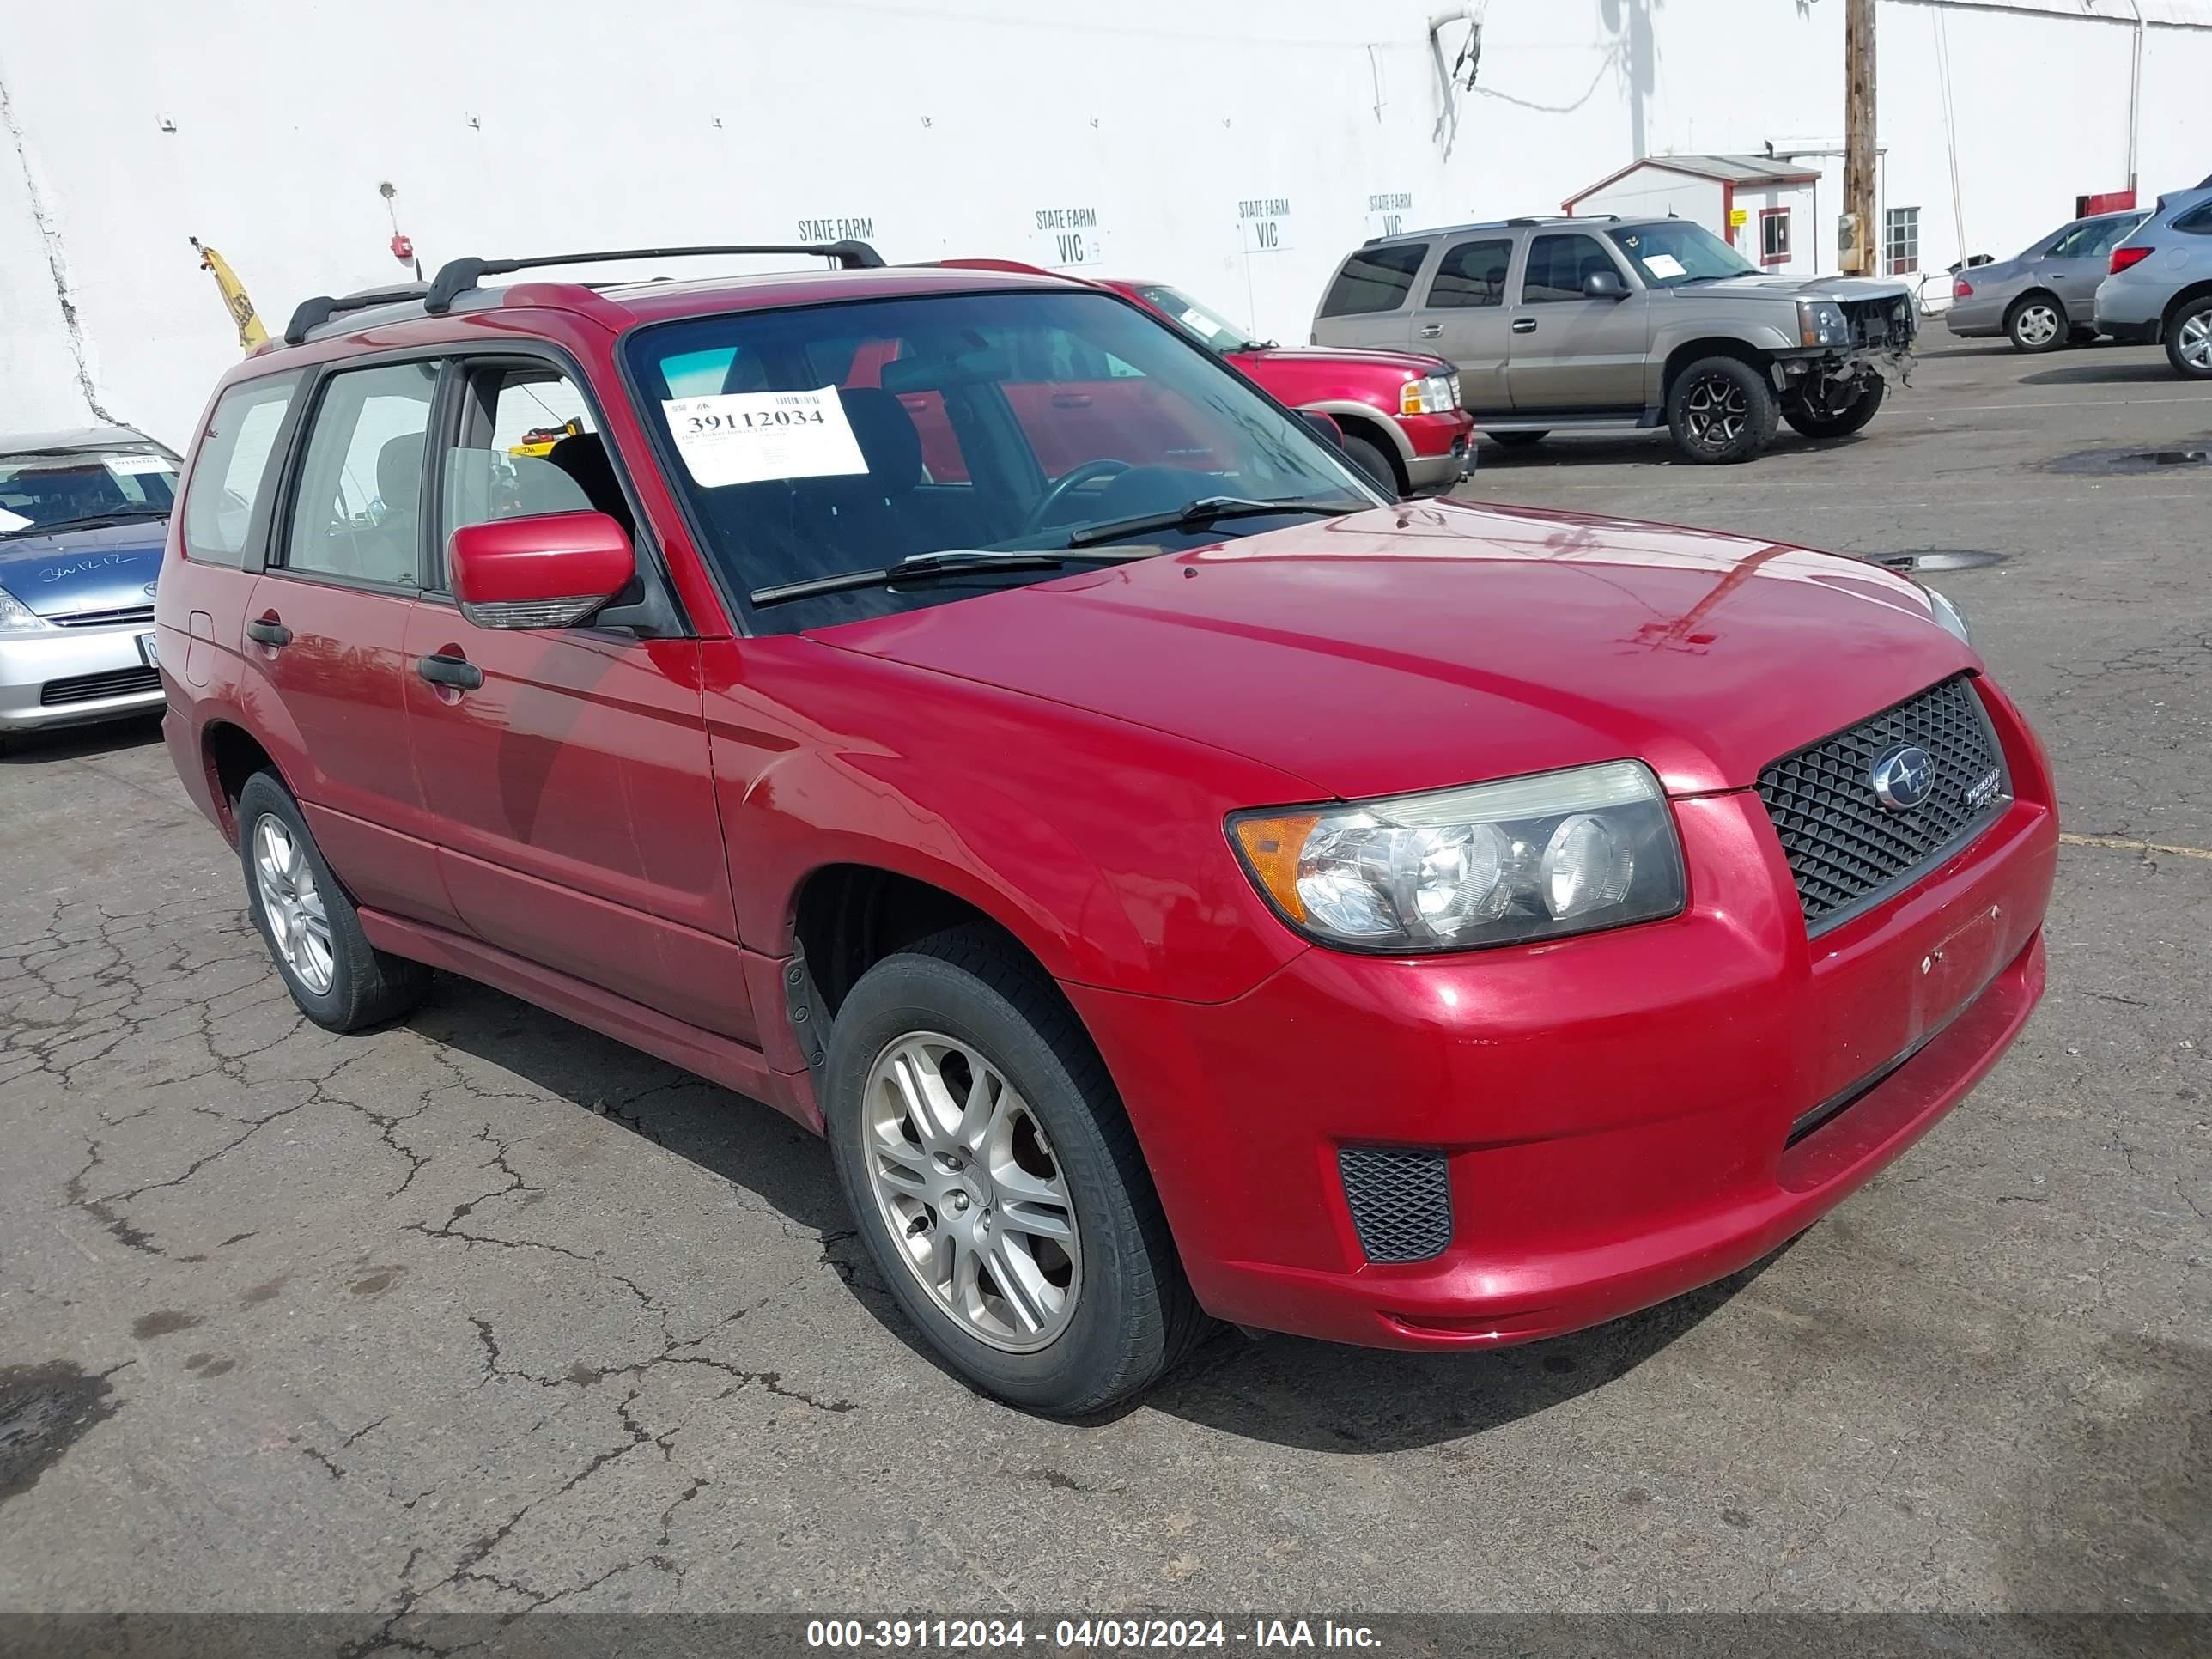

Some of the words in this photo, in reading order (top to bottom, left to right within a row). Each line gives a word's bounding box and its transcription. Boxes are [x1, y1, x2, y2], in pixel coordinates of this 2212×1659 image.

[1036, 210, 1066, 230] STATE
[1066, 207, 1097, 228] FARM
[1238, 200, 1264, 218] STATE
[1265, 198, 1290, 216] FARM
[798, 219, 836, 241] STATE
[837, 217, 874, 241] FARM
[1255, 222, 1278, 247] VIC
[1056, 234, 1083, 263] VIC
[687, 410, 824, 433] 39112034
